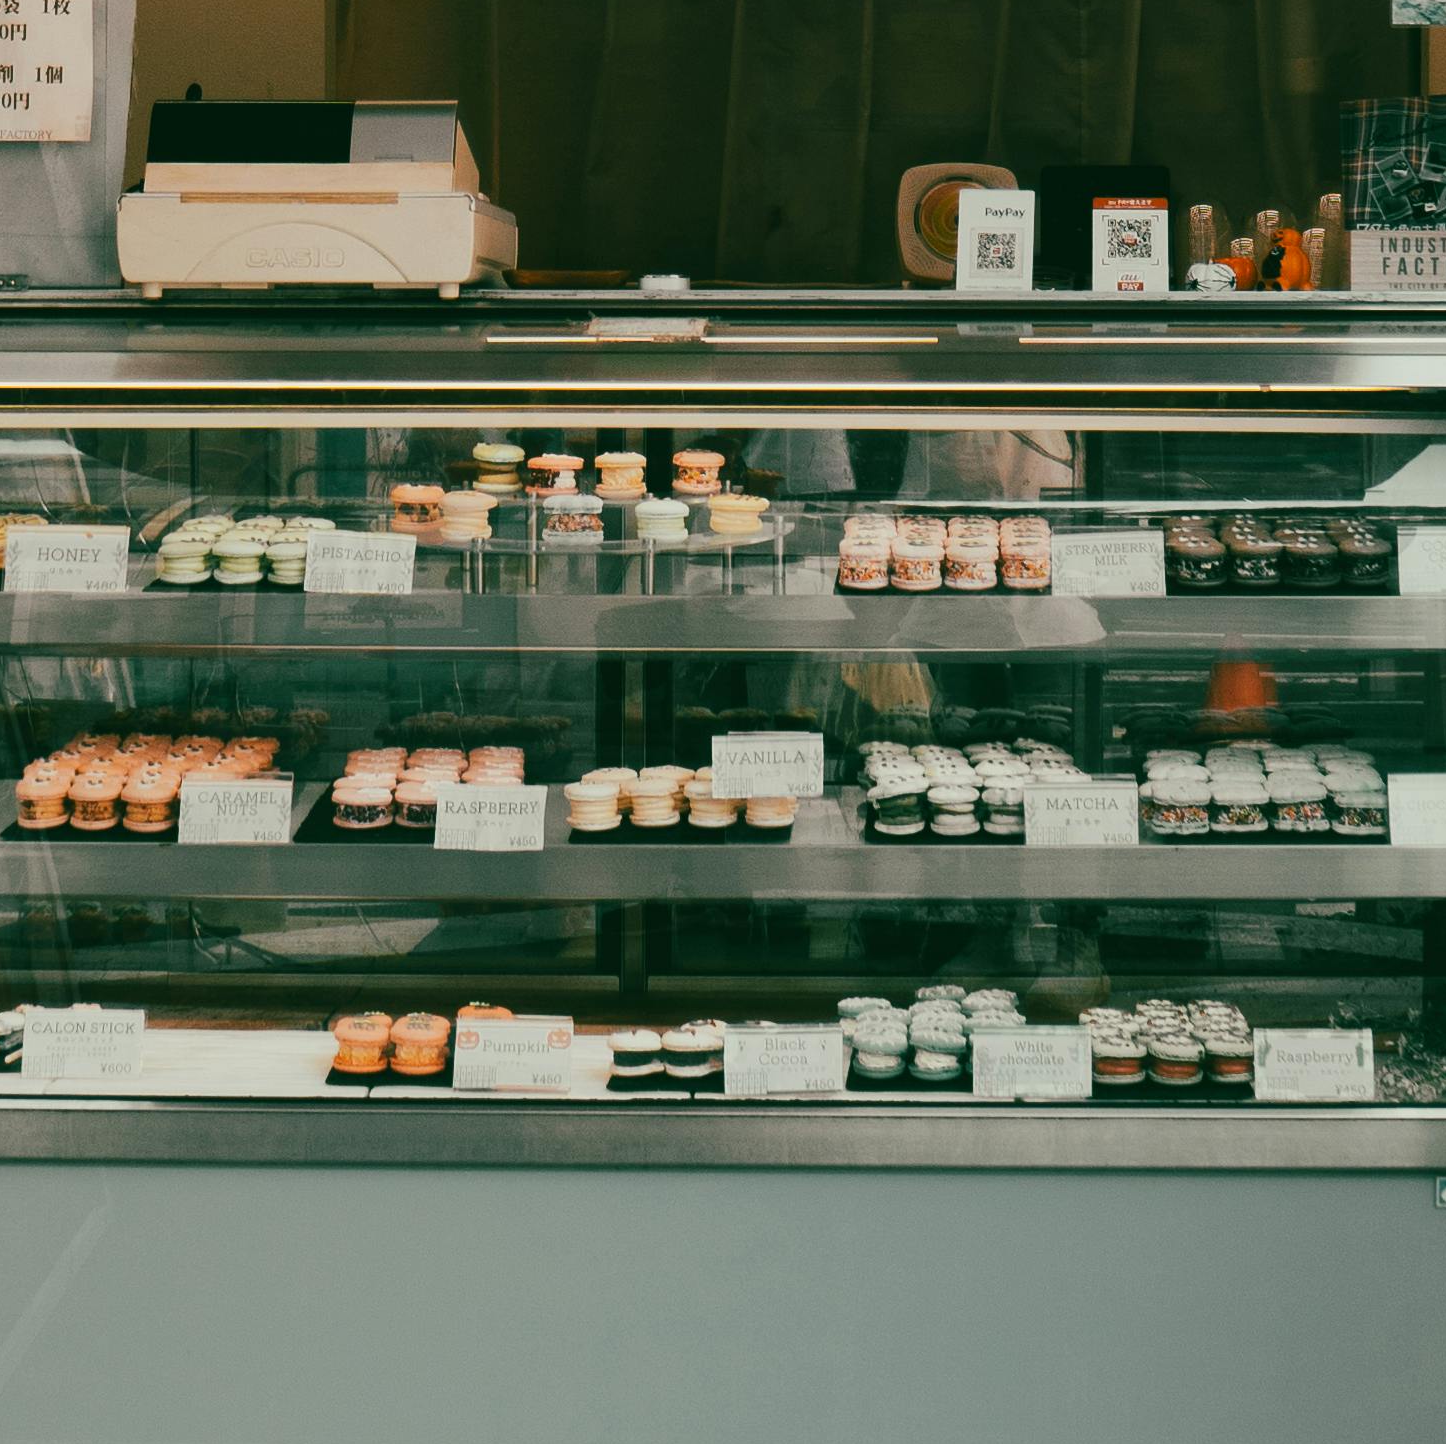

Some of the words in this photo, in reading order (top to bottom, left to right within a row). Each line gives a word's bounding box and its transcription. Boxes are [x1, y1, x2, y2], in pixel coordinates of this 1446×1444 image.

[34, 65, 64, 84] 1個
[0, 129, 53, 140] FACTORY
[985, 206, 1026, 219] PayPay
[245, 248, 346, 269] CASIO
[37, 547, 102, 563] HONEY
[321, 547, 403, 563] PISTACHIO
[1065, 542, 1154, 556] STRAWBERRY
[1094, 555, 1128, 567] MILK
[727, 750, 805, 765] VANILLA
[198, 791, 277, 804] CARAMEL
[1045, 797, 1119, 811] MATCHA
[217, 803, 258, 816] NUTS
[444, 800, 539, 816] RASPBERRY
[32, 1021, 86, 1034] CALON
[90, 1022, 135, 1034] STICK
[482, 1039, 551, 1056] Pumpkin
[764, 1038, 807, 1052] Black
[1013, 1040, 1054, 1053] White
[758, 1052, 810, 1065] Cocoa
[999, 1053, 1065, 1066] chocolate
[1276, 1049, 1354, 1065] Raspberry
